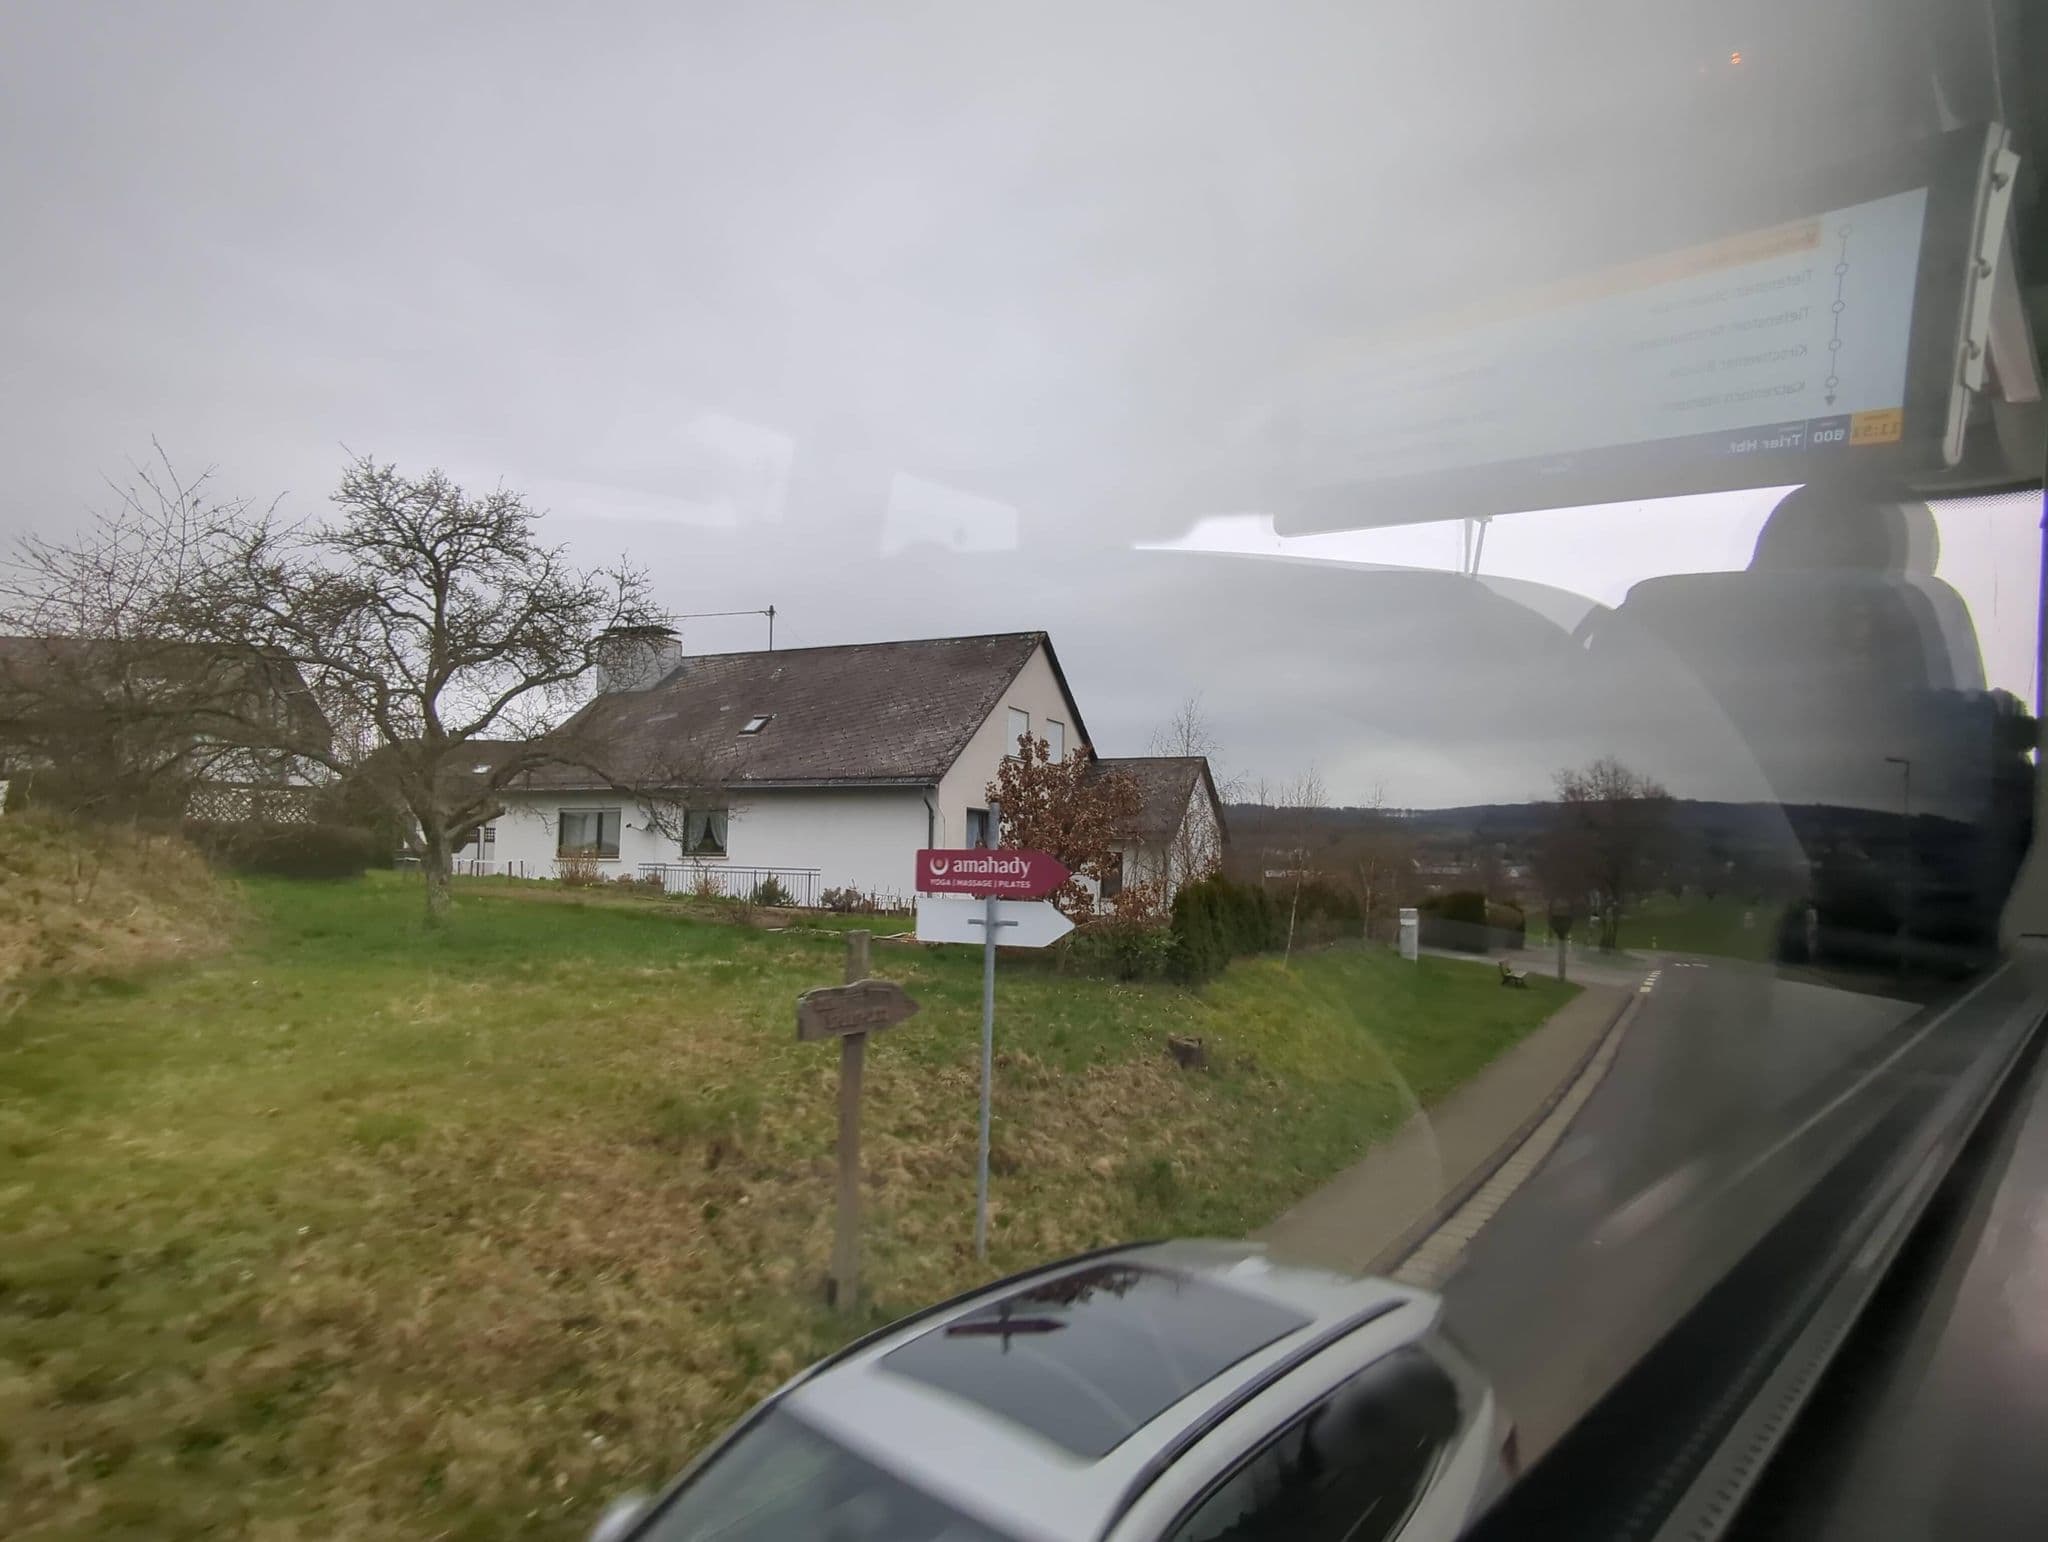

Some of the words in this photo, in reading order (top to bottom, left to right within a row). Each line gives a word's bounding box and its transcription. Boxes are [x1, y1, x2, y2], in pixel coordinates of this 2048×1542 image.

[953, 856, 1032, 878] amahady
[956, 880, 993, 888] MASSAGE
[999, 880, 1031, 888] PILATES
